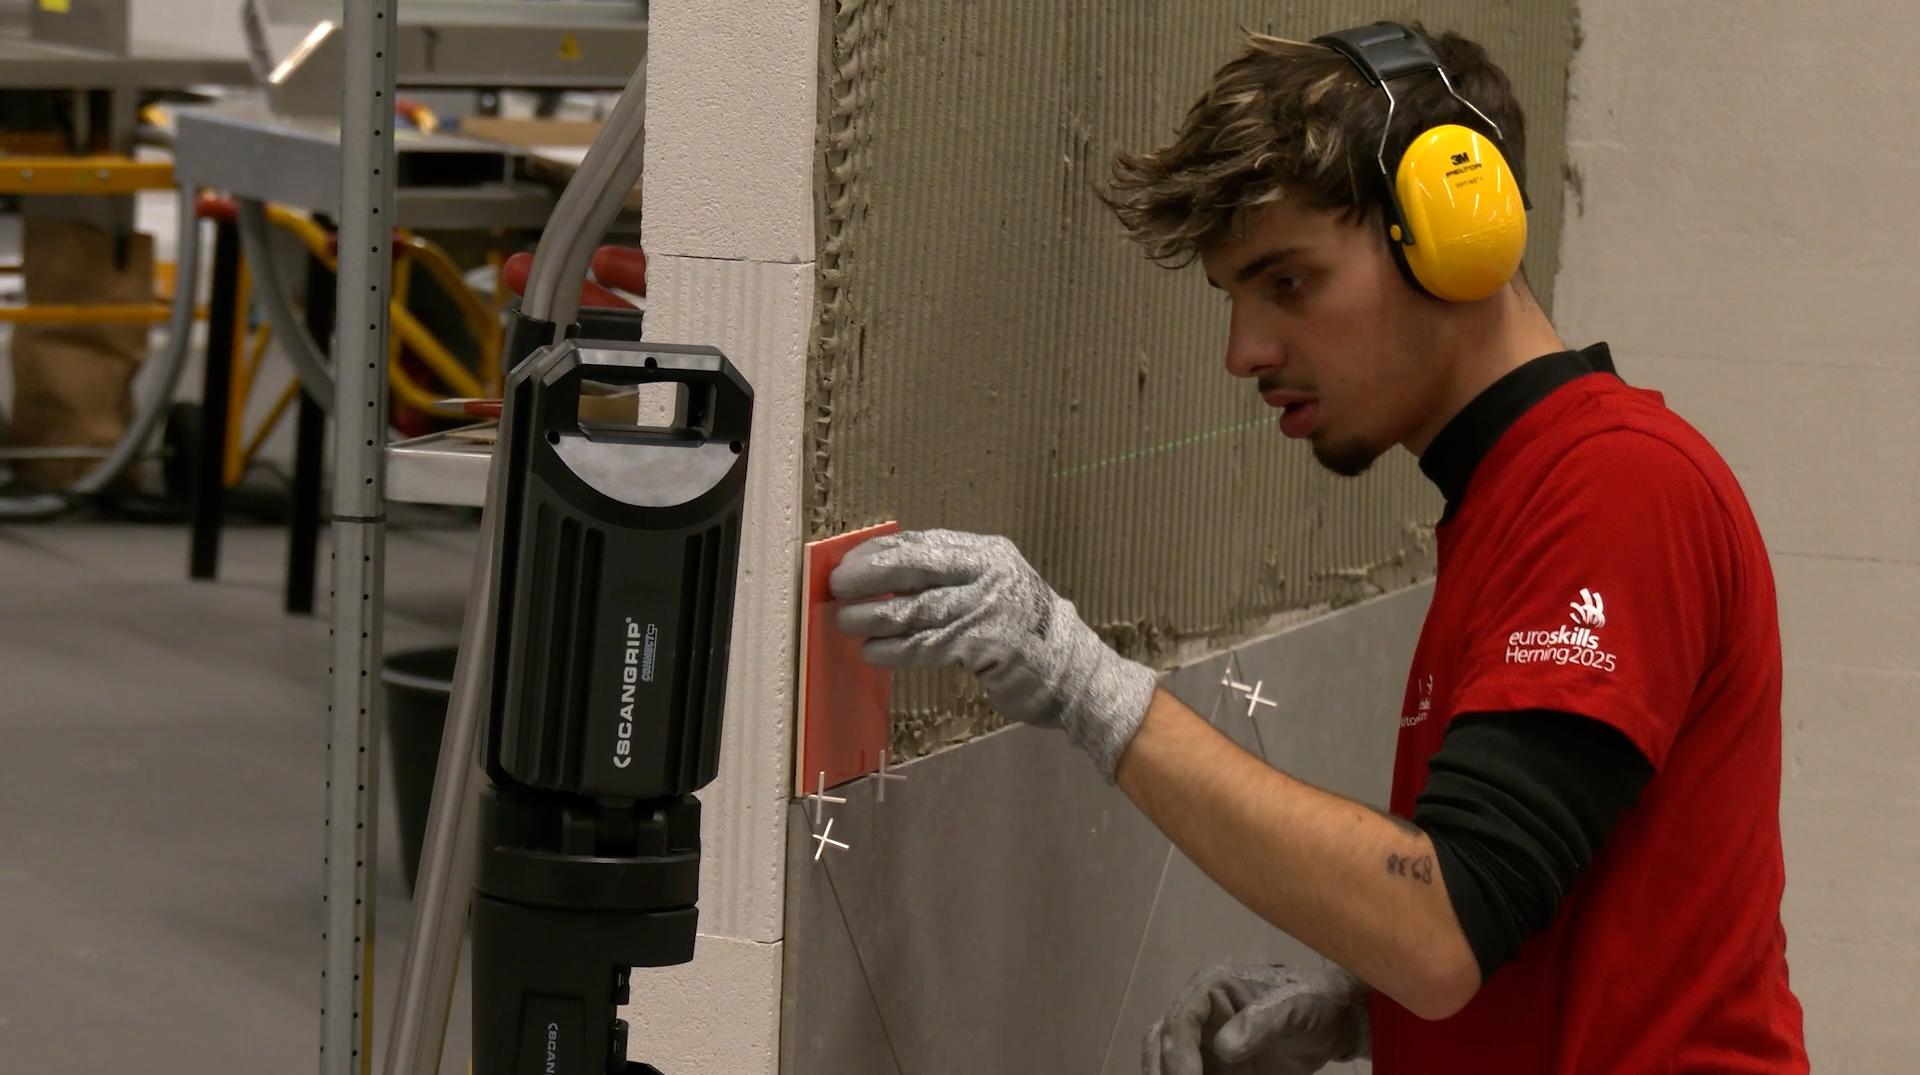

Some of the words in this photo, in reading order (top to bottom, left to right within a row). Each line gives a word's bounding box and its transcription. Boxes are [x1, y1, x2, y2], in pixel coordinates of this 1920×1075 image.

[1450, 152, 1470, 166] 3M
[1446, 163, 1482, 177] PELTOR
[1508, 624, 1600, 650] euroskills
[611, 621, 641, 757] SCANGRIP
